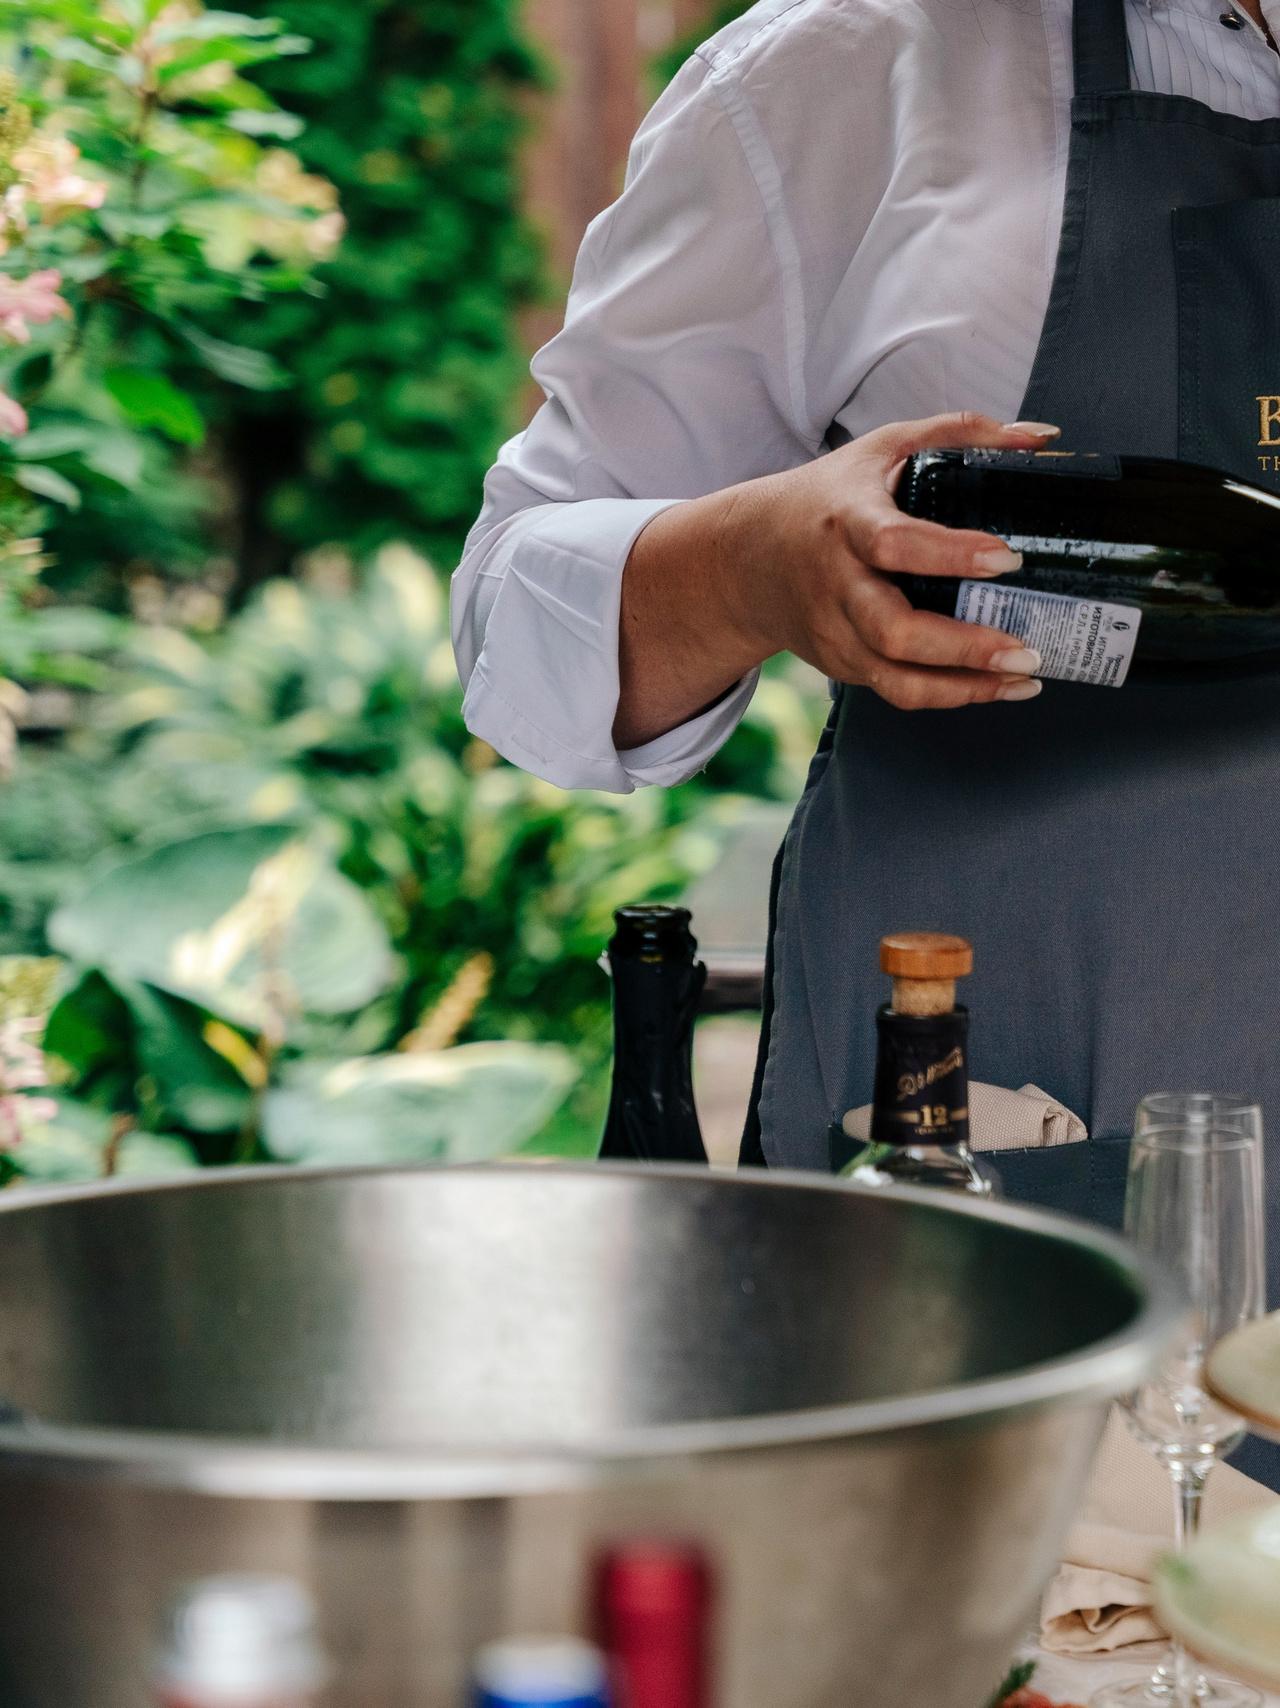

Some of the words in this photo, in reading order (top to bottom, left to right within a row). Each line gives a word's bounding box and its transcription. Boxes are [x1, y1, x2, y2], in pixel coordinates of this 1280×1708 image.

[963, 583, 973, 605] Место
[1077, 604, 1089, 635] С.Р.Л.»
[1081, 606, 1102, 669] ИЗГОТОВИТЕЛЬ:
[1090, 636, 1107, 674] ИГРИСТОЕ
[920, 1104, 948, 1126] 12
